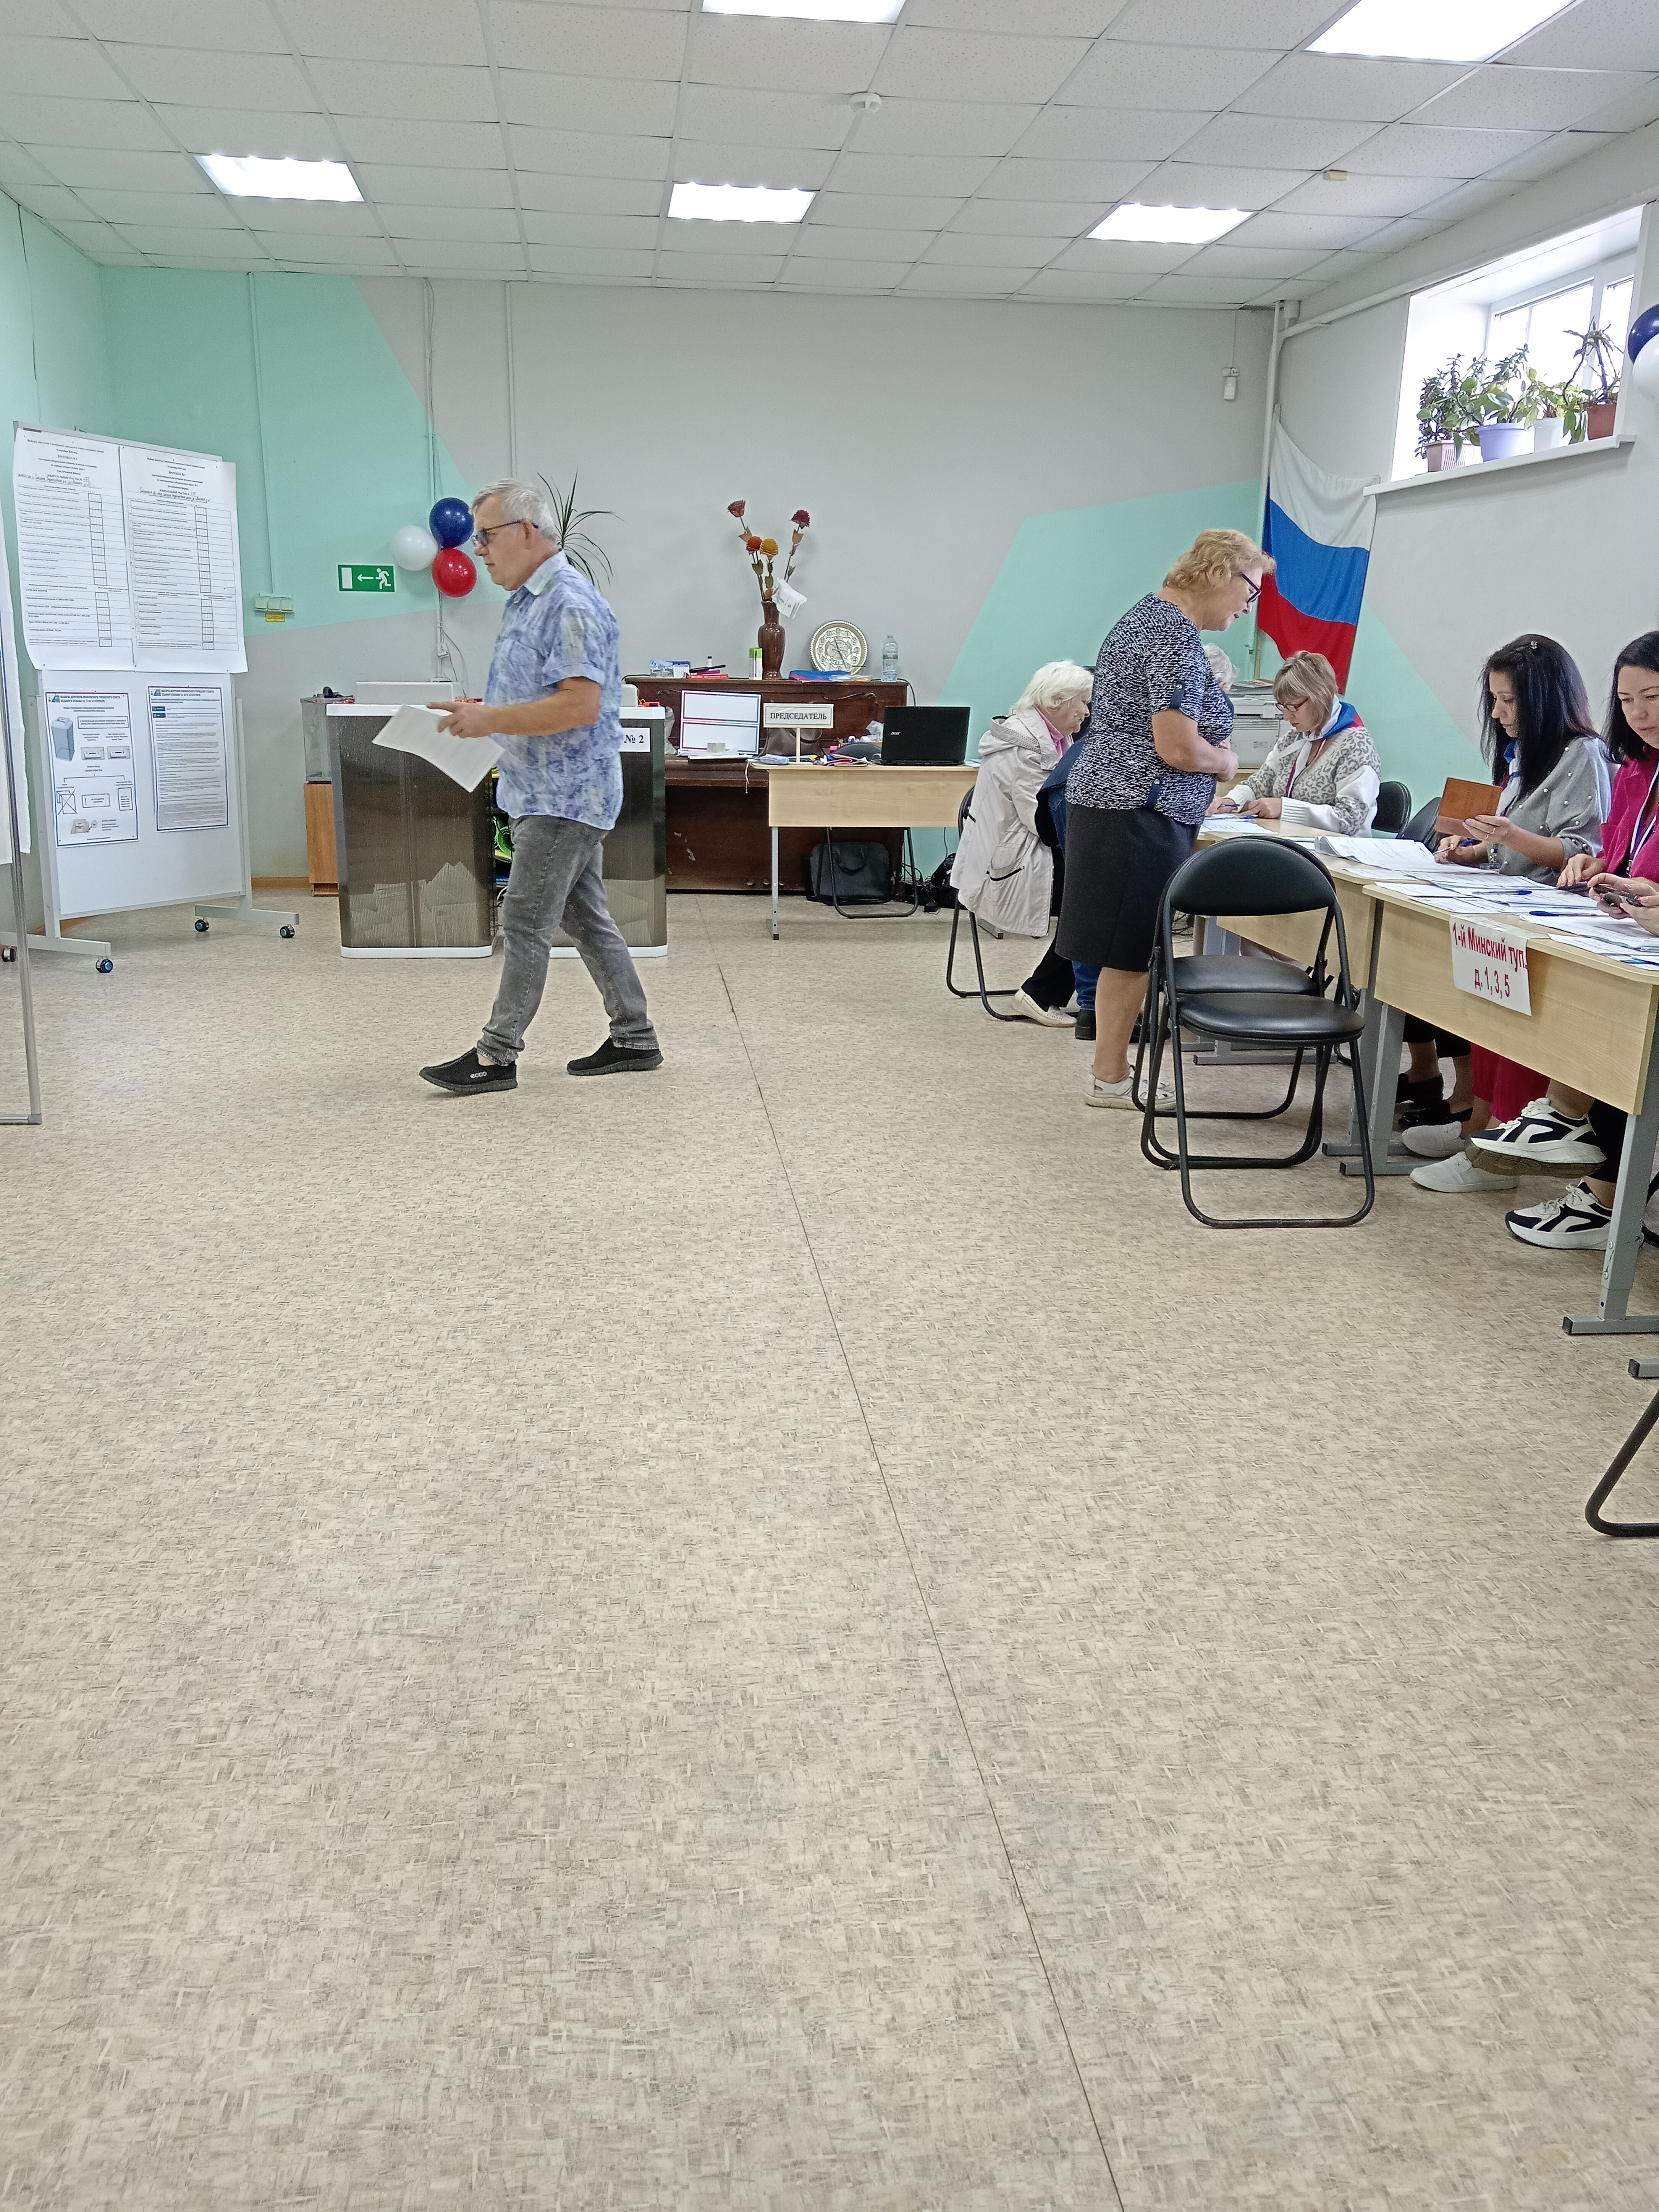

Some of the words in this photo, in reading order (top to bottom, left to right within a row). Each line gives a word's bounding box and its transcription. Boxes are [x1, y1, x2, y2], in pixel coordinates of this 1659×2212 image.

[624, 734, 635, 743] №
[639, 735, 644, 743] 2
[1453, 923, 1466, 948] 1-й
[1468, 927, 1507, 962] Минский
[1504, 974, 1510, 998] 5
